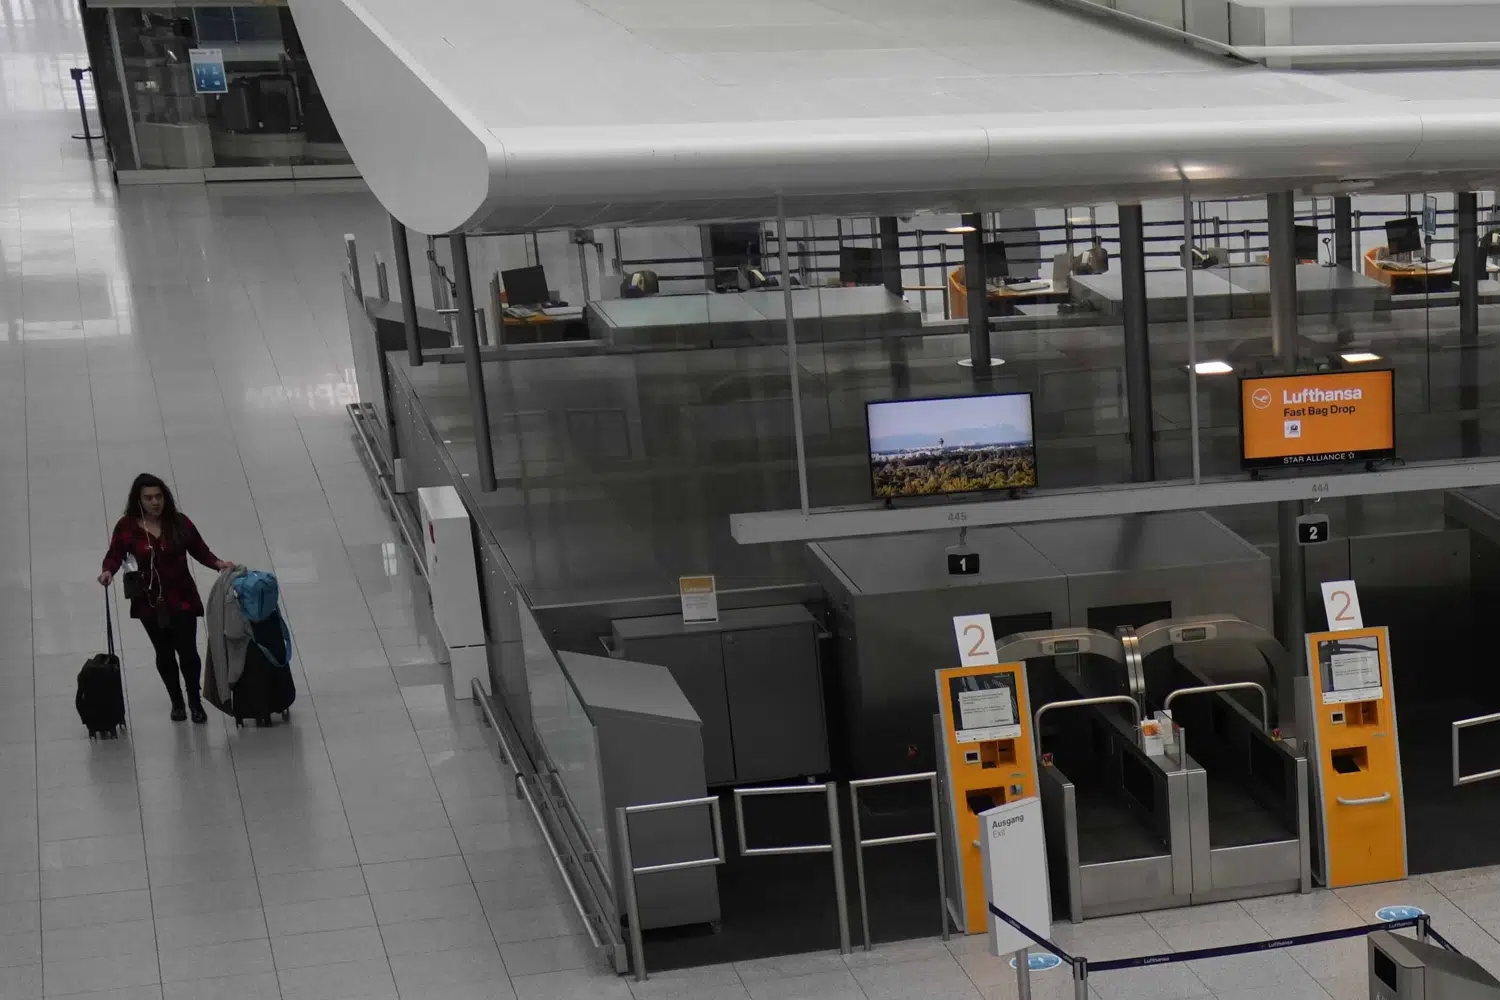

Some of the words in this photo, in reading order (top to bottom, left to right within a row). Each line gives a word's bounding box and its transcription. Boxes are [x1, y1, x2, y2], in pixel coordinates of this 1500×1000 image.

[1283, 388, 1363, 404] Lufthansa
[1283, 407, 1306, 417] Fast
[1308, 406, 1329, 416] Bag
[1330, 404, 1356, 415] Drop
[1283, 455, 1304, 464] STAR
[1306, 453, 1346, 463] ALLIANCE
[1311, 483, 1329, 493] 444
[947, 511, 967, 521] 445
[1309, 526, 1318, 540] 2
[959, 557, 967, 572] 1
[1330, 590, 1355, 621] 2
[963, 623, 990, 657] 2
[992, 814, 1025, 829] Ausgang
[992, 829, 1006, 839] Exit
[1268, 939, 1293, 948] Lufthansa
[1143, 956, 1170, 965] Lufthansa
